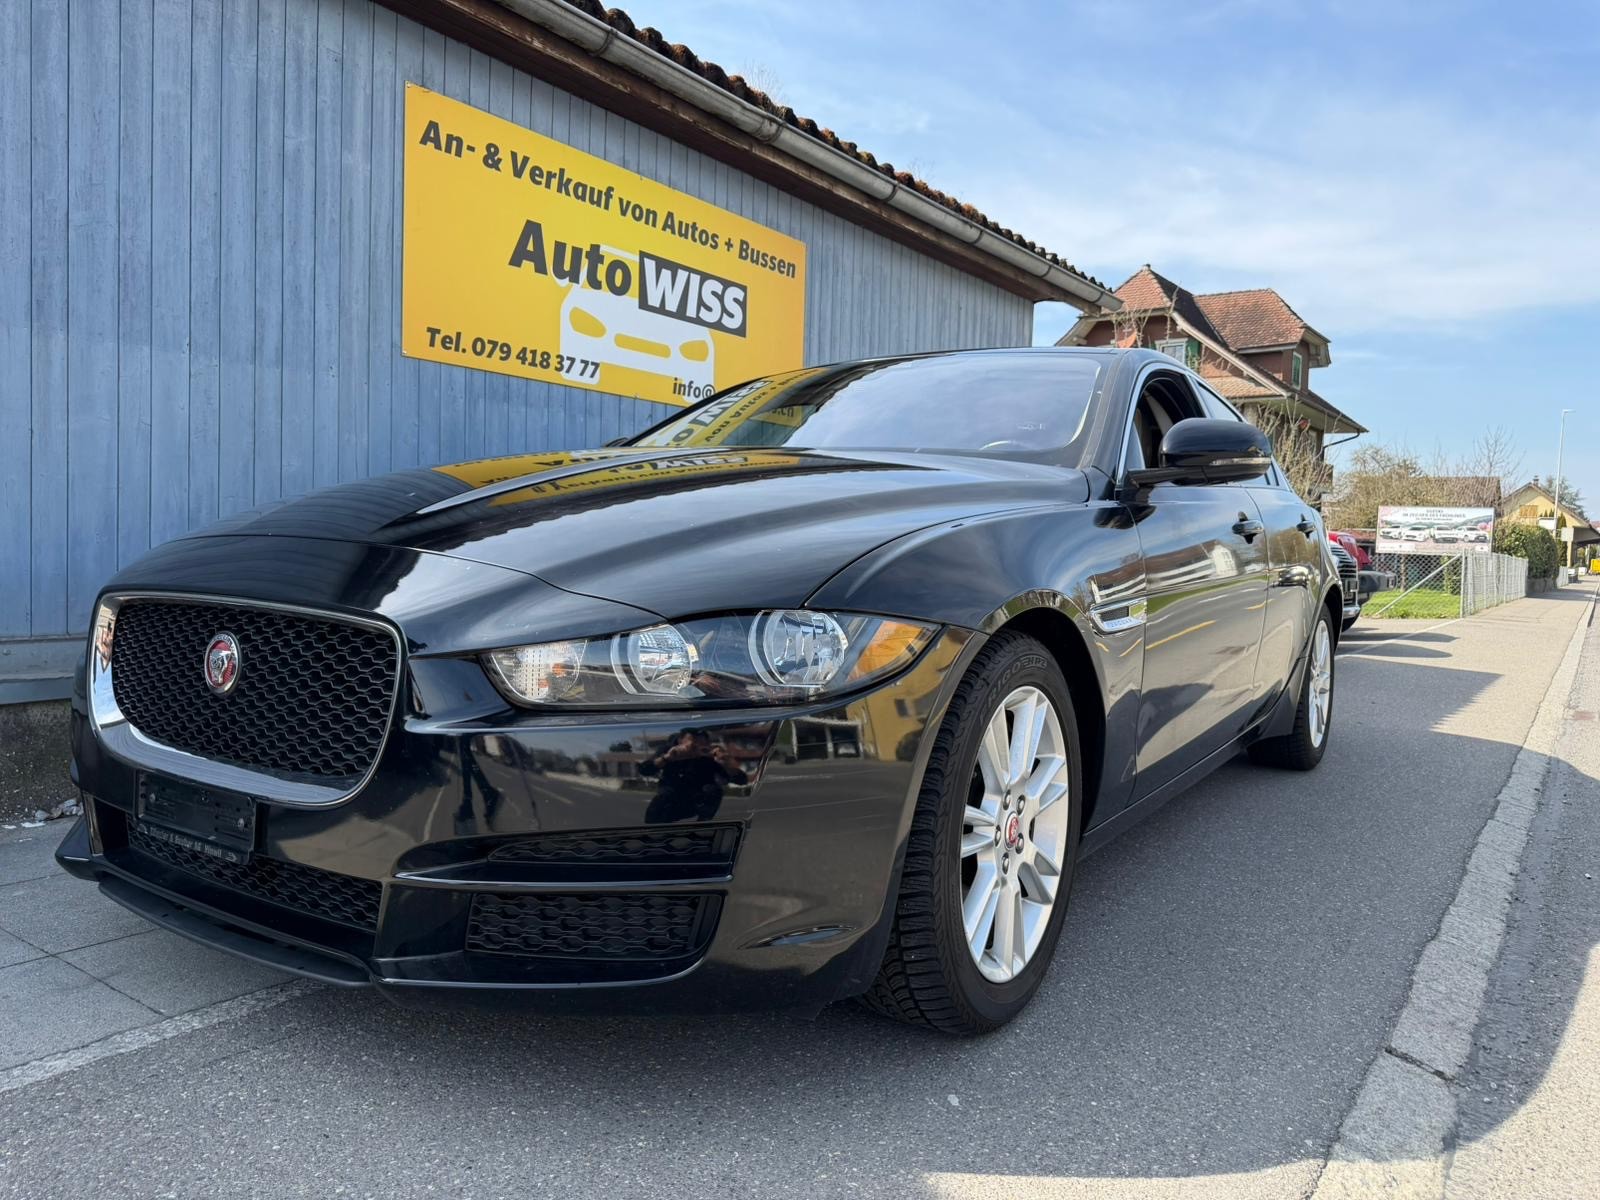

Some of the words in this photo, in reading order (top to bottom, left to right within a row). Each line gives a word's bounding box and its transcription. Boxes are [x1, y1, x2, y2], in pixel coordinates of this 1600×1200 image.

[419, 120, 475, 158] An-
[482, 143, 502, 172] &
[510, 151, 614, 211] Verkauf
[618, 196, 658, 228] von
[661, 211, 719, 250] Autos
[724, 237, 734, 253] +
[738, 238, 797, 279] Bussen
[508, 219, 632, 297] Auto
[643, 258, 746, 331] WISS
[426, 327, 467, 355] Tel.
[471, 337, 512, 361] 079
[515, 347, 551, 371] 418
[554, 354, 576, 375] 37
[579, 359, 601, 380] 77
